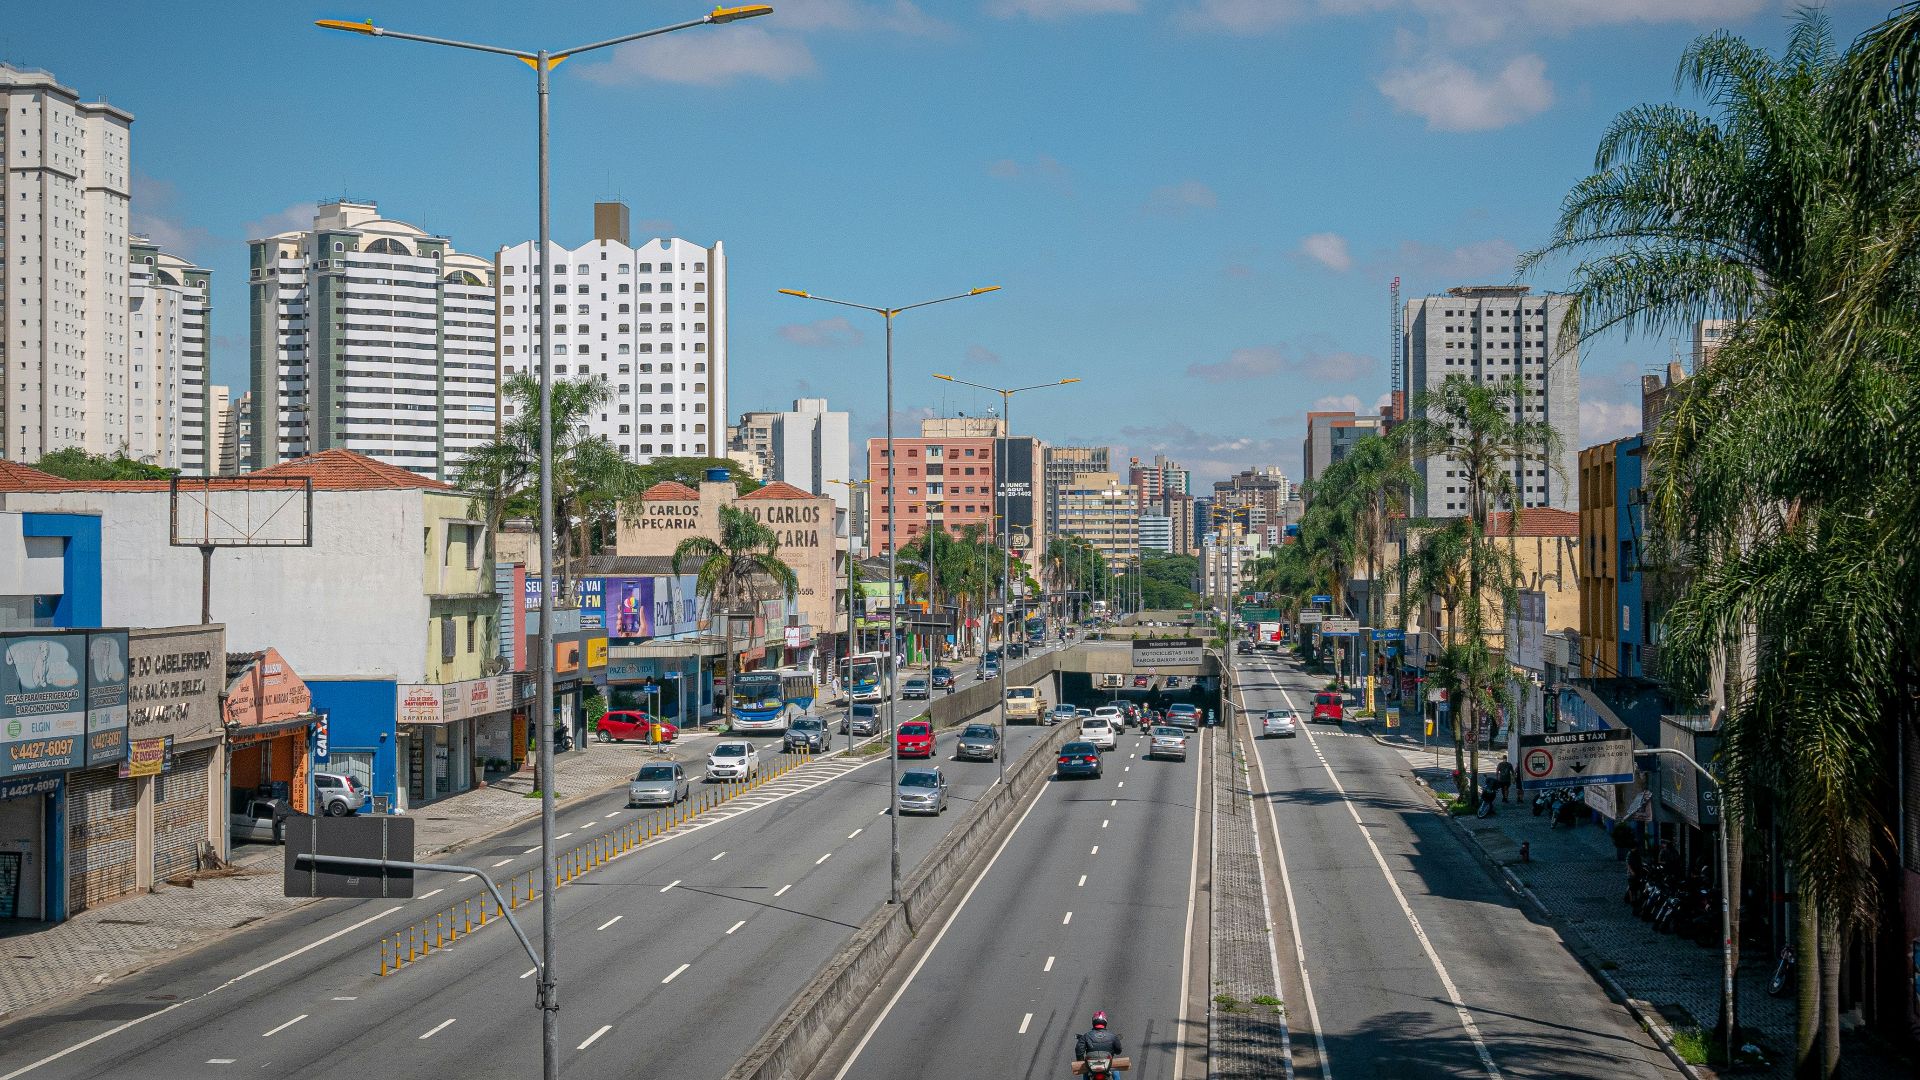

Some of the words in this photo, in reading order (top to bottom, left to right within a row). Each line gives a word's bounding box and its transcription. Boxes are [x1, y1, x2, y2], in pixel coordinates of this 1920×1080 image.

[649, 505, 699, 517] CARLOS
[767, 506, 820, 523] CARLOS
[623, 518, 697, 531] TAPEÇARIA
[525, 581, 542, 592] SEU
[586, 580, 601, 591] VAI
[586, 595, 601, 607] FM
[656, 601, 668, 626] PAZ
[683, 599, 697, 623] VIDA
[139, 655, 151, 677] DO
[5, 694, 24, 705] PEÇAS
[25, 692, 38, 703] PARA
[38, 689, 79, 702] REFRIGERAÇÃO
[32, 721, 51, 733] ELGIN
[316, 714, 327, 757] CAIXA
[1545, 734, 1576, 744] ÔNIBUS
[1587, 732, 1606, 740] TÁXI
[19, 739, 73, 759] 4427-6097
[9, 779, 60, 796] 4427-6097
